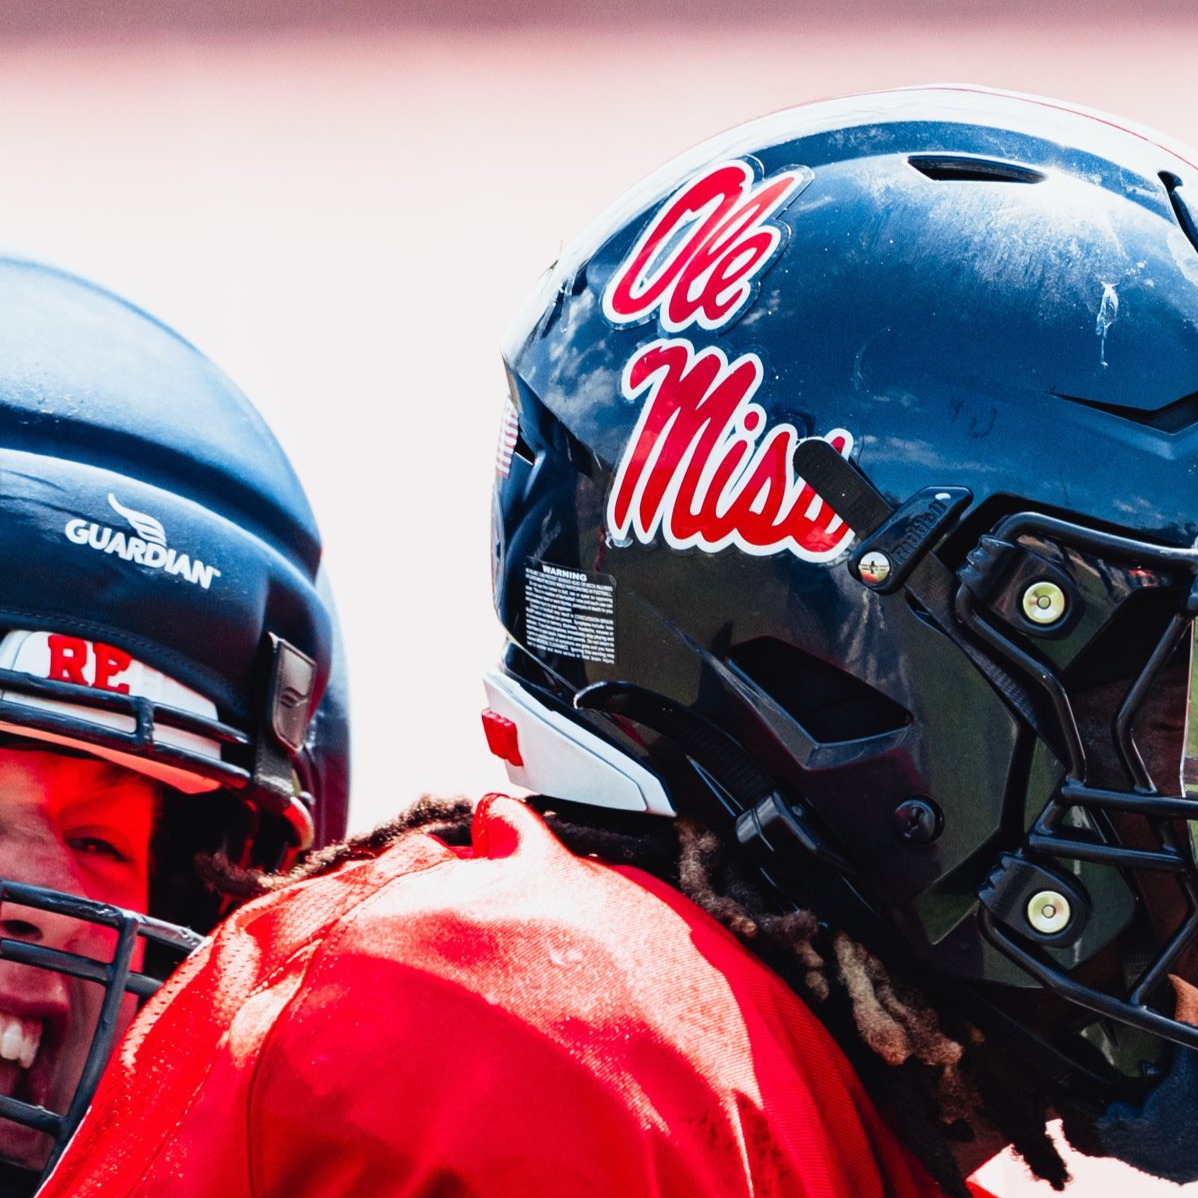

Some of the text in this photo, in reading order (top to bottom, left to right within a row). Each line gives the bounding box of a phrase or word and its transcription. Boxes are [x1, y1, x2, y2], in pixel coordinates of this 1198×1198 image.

[602, 159, 804, 332] Ole
[64, 518, 221, 590] GUARDIAN
[542, 564, 588, 582] WARNING
